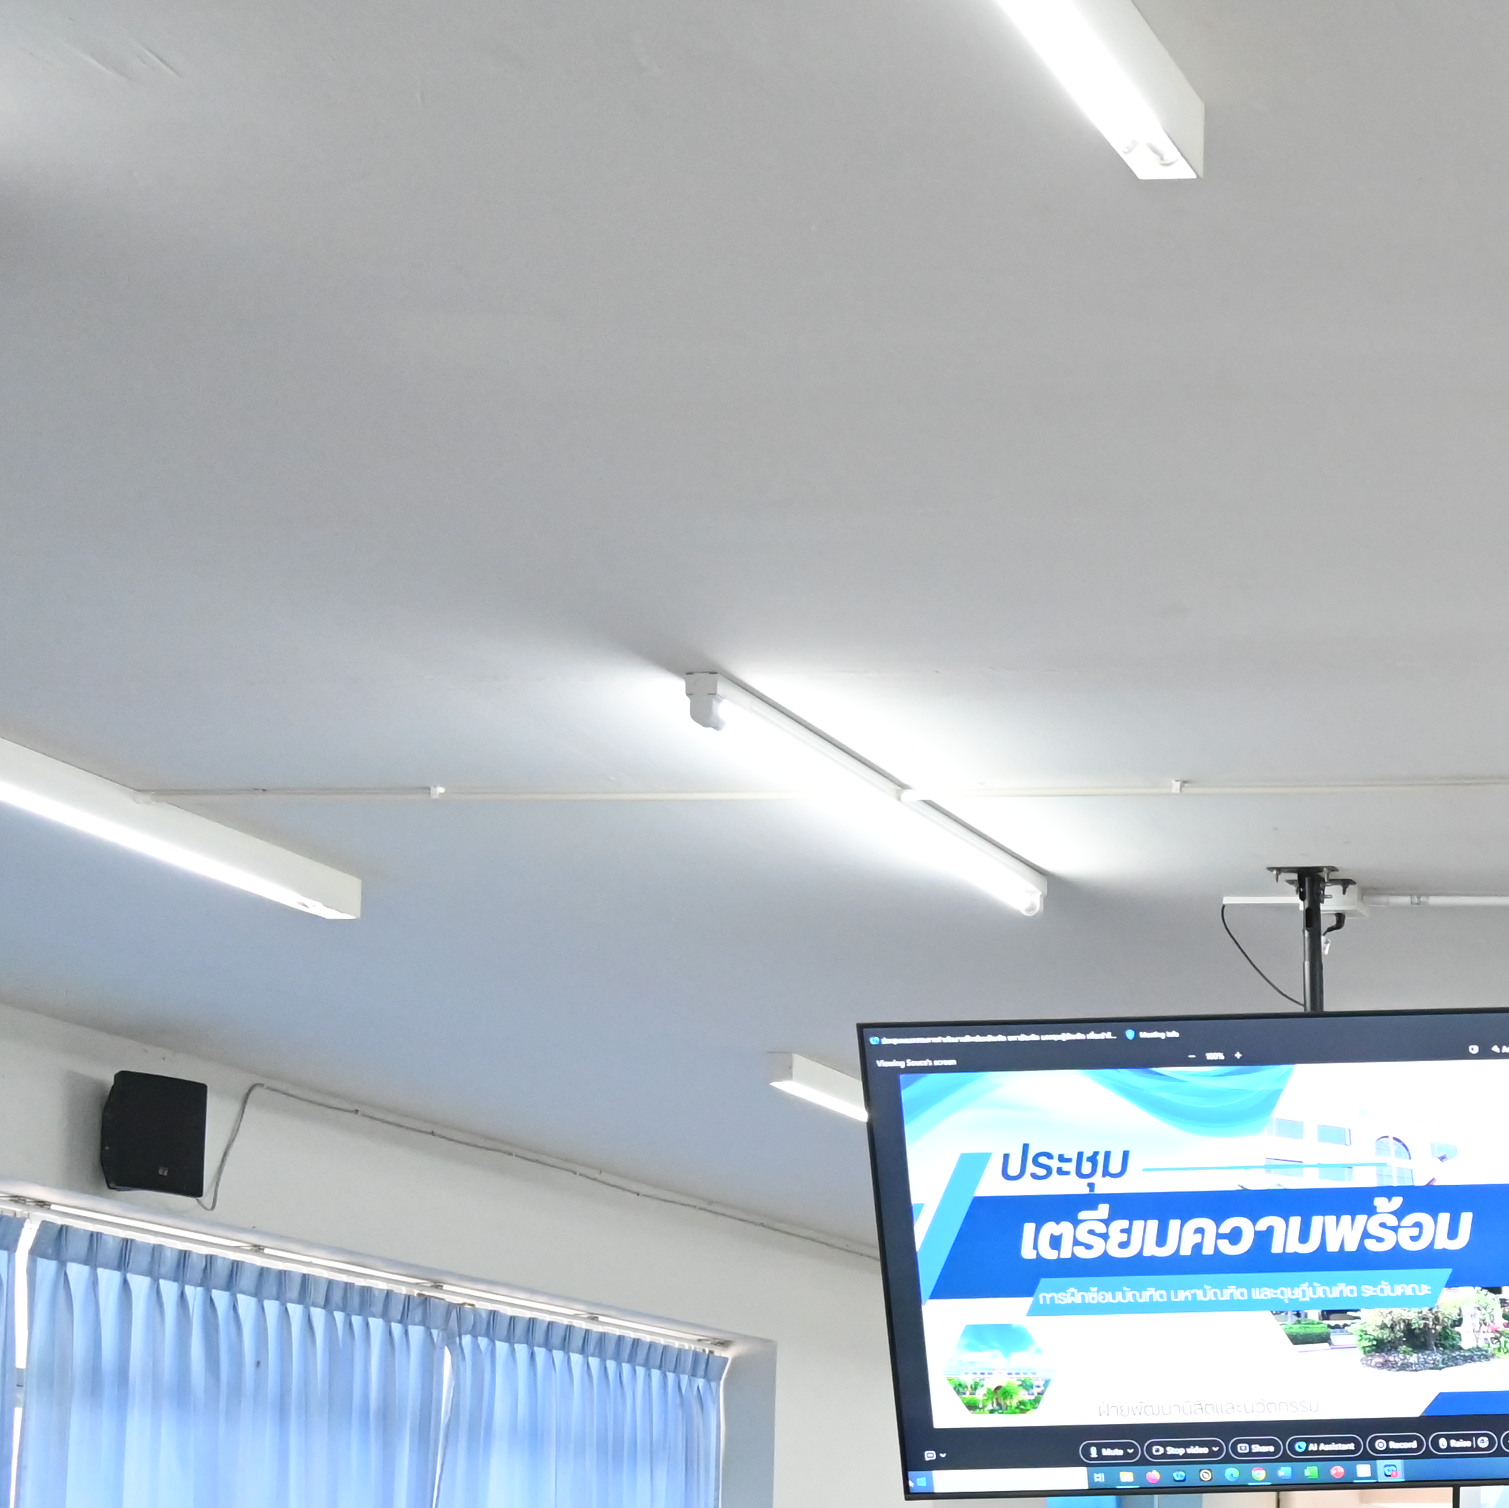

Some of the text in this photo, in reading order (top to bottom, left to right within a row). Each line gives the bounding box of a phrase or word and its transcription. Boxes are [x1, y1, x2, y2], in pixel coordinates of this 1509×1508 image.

[876, 1059, 905, 1068] Viewing
[1000, 1143, 1130, 1192] ประชุม
[1020, 1196, 1473, 1260] เตรียมความพร้อม
[1039, 1278, 1432, 1305] การฝึกซ้อมบัณฑิต มหาบัณฑิต และดุษฎีบัณฑิต ระดับคณะ
[1251, 1443, 1274, 1453] Share
[1308, 1441, 1355, 1451] AI Assistant
[1389, 1439, 1417, 1449] Record
[1102, 1447, 1123, 1457] Mute
[1166, 1445, 1209, 1457] Stop video
